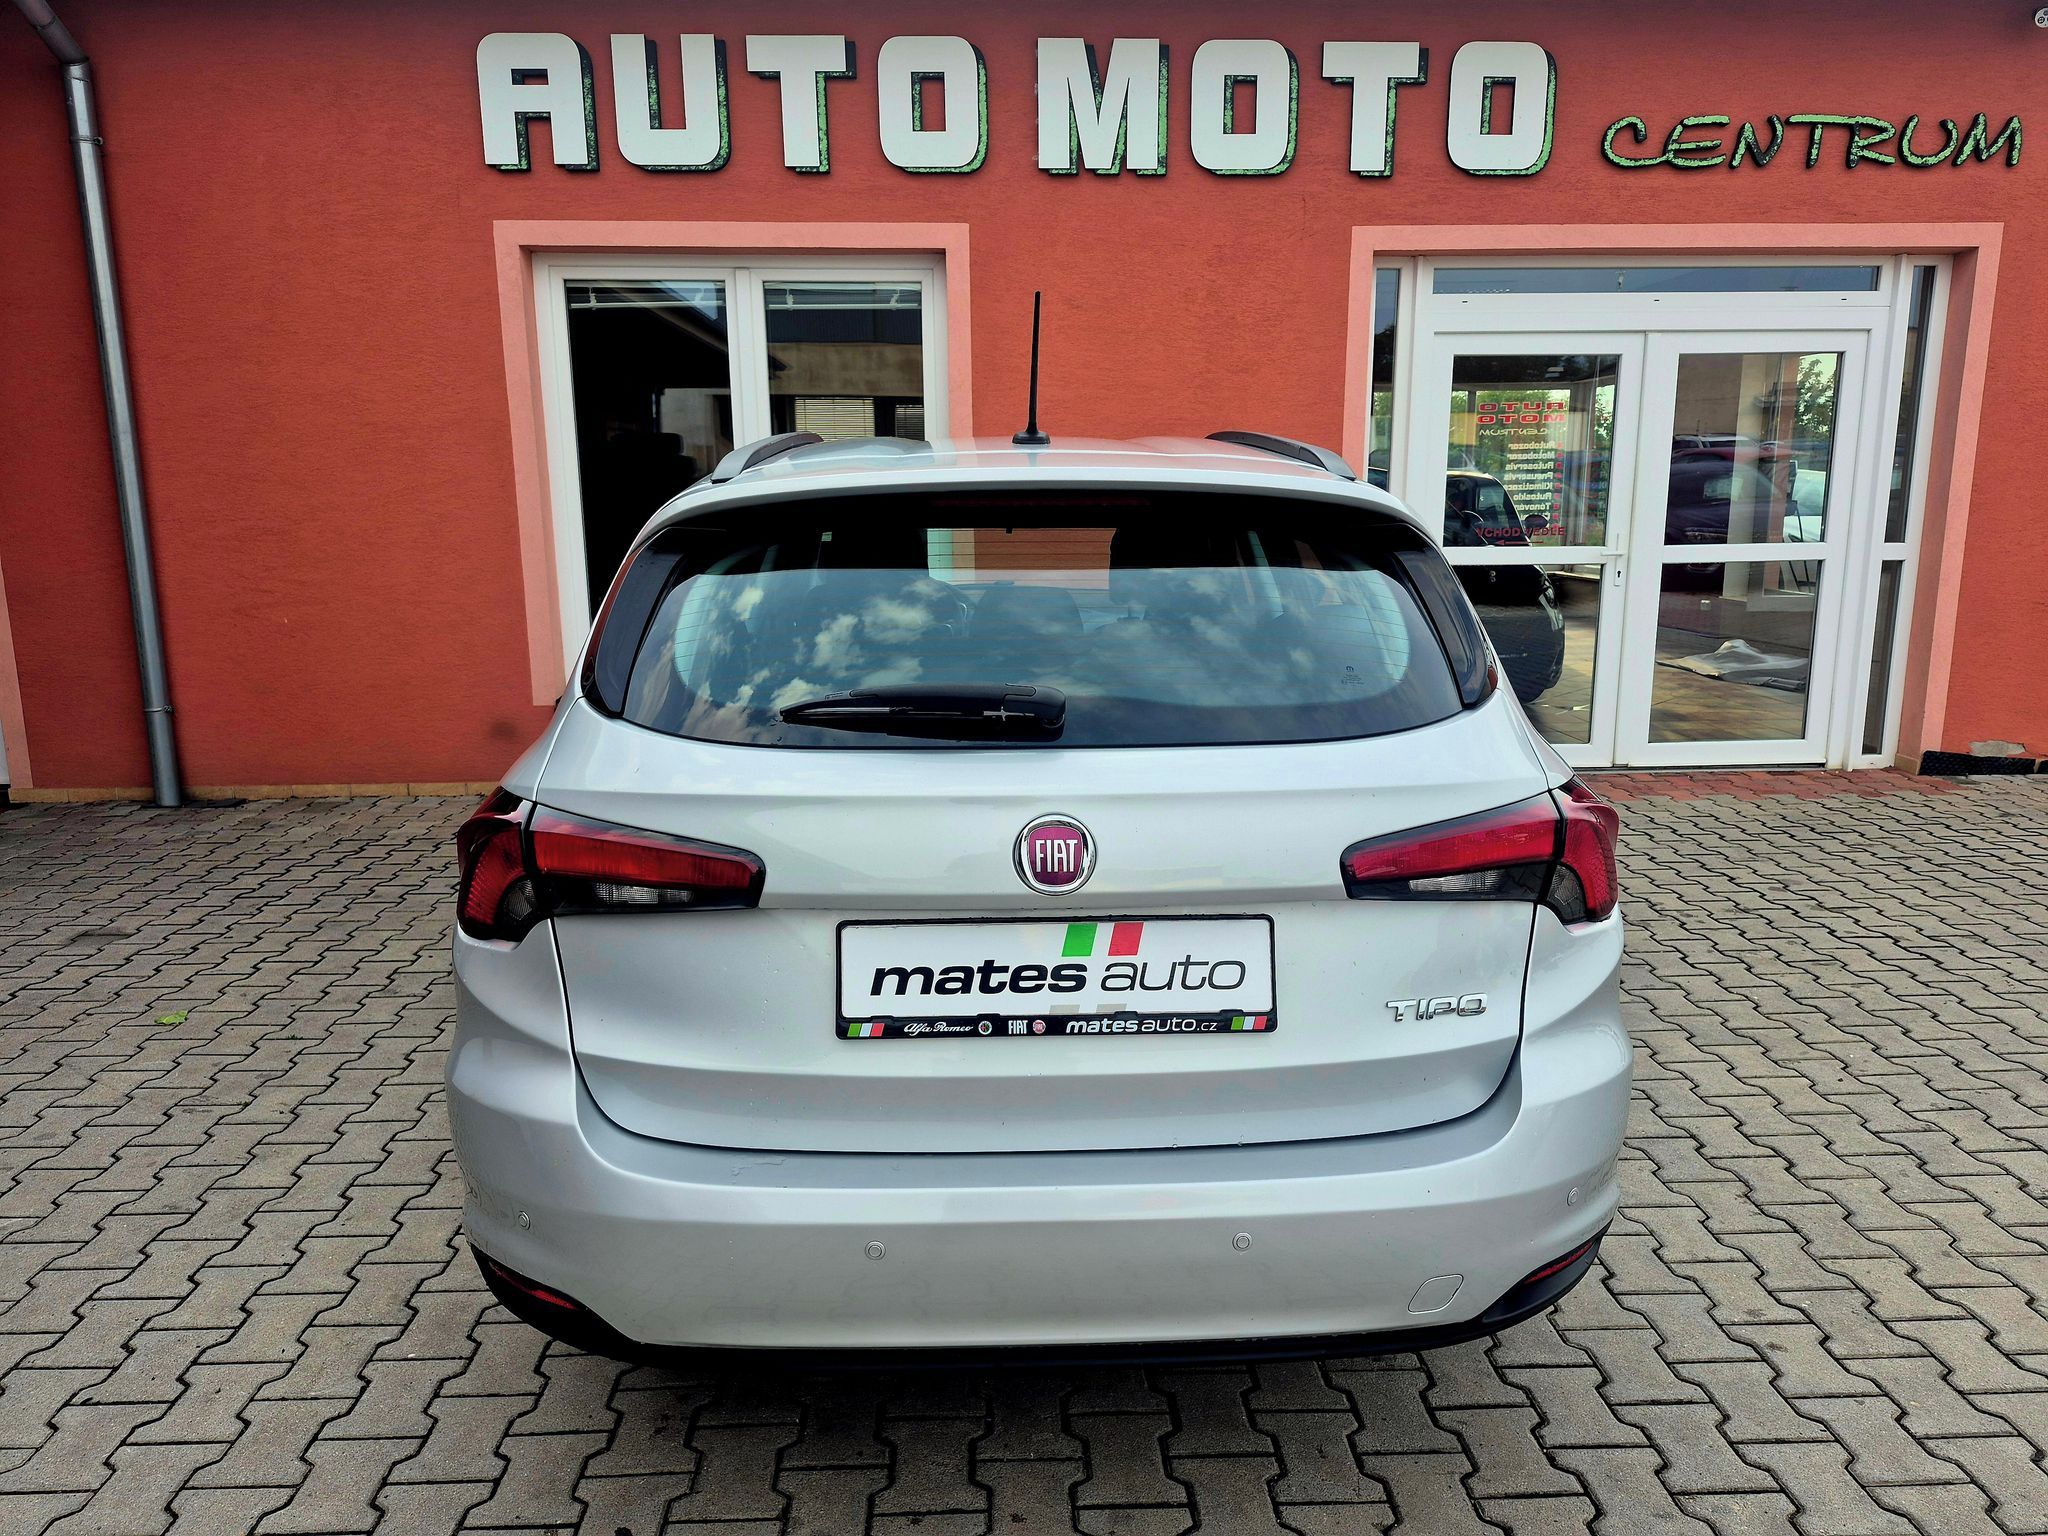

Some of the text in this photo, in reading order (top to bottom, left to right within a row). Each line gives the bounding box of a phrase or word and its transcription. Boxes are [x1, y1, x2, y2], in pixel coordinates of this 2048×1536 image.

[476, 32, 2023, 177] AUTO MOTO CENTRUM
[1476, 527, 1566, 538] VCHOD VEDLE
[1035, 839, 1079, 873] FIAT
[870, 954, 1246, 996] mates auto
[1386, 993, 1488, 1022] TIPO
[903, 1022, 933, 1037] Alfa
[932, 1021, 974, 1033] Romeo
[1008, 1019, 1029, 1035] FIAT
